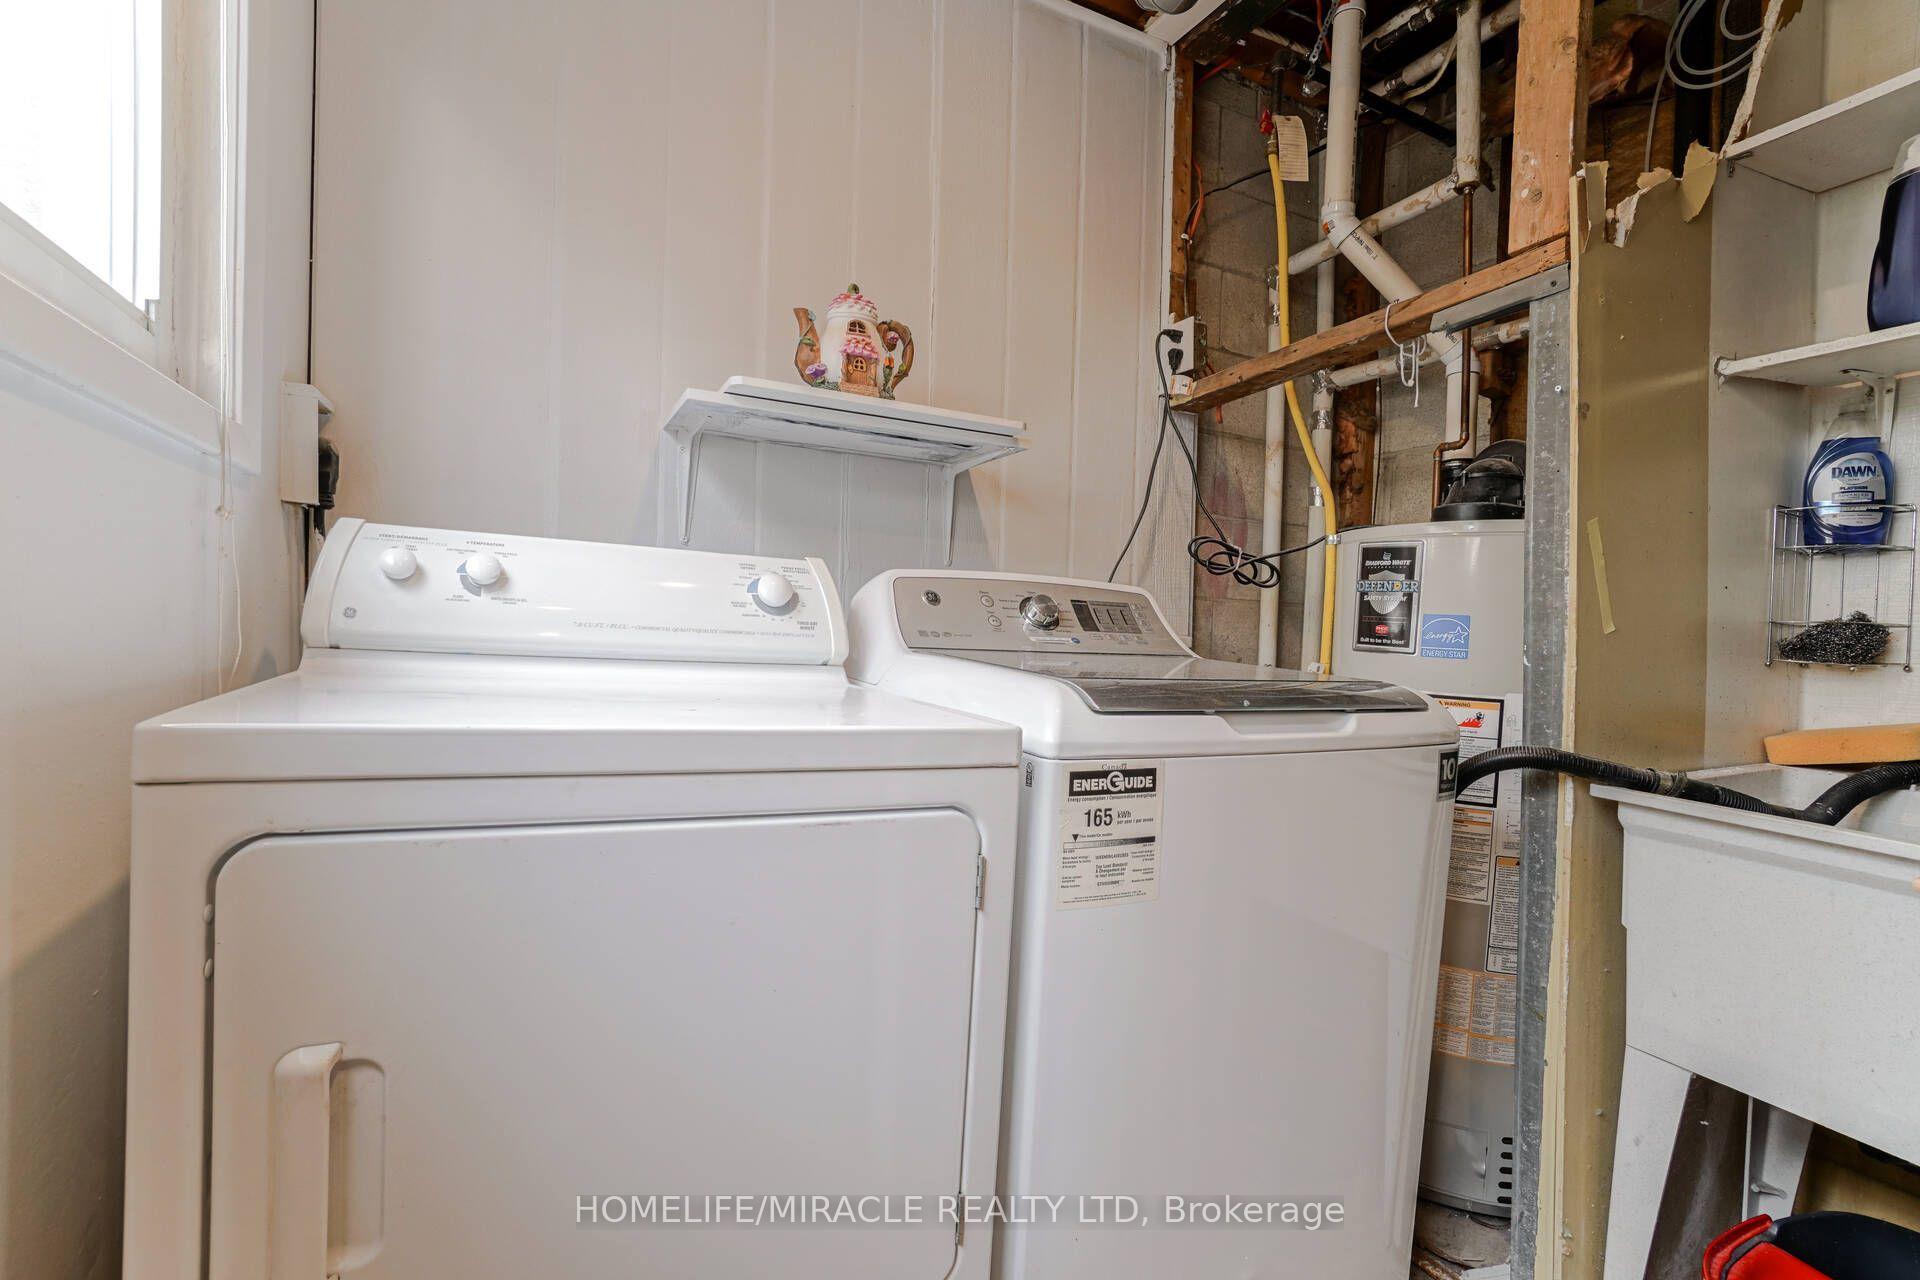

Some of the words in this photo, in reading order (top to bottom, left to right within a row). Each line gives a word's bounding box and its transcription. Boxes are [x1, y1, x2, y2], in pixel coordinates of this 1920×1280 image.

[1831, 465, 1877, 478] DAWN
[1358, 581, 1418, 592] DEFENDER
[1442, 758, 1456, 780] 10
[1084, 808, 1113, 827] 165
[1117, 811, 1132, 819] kWh
